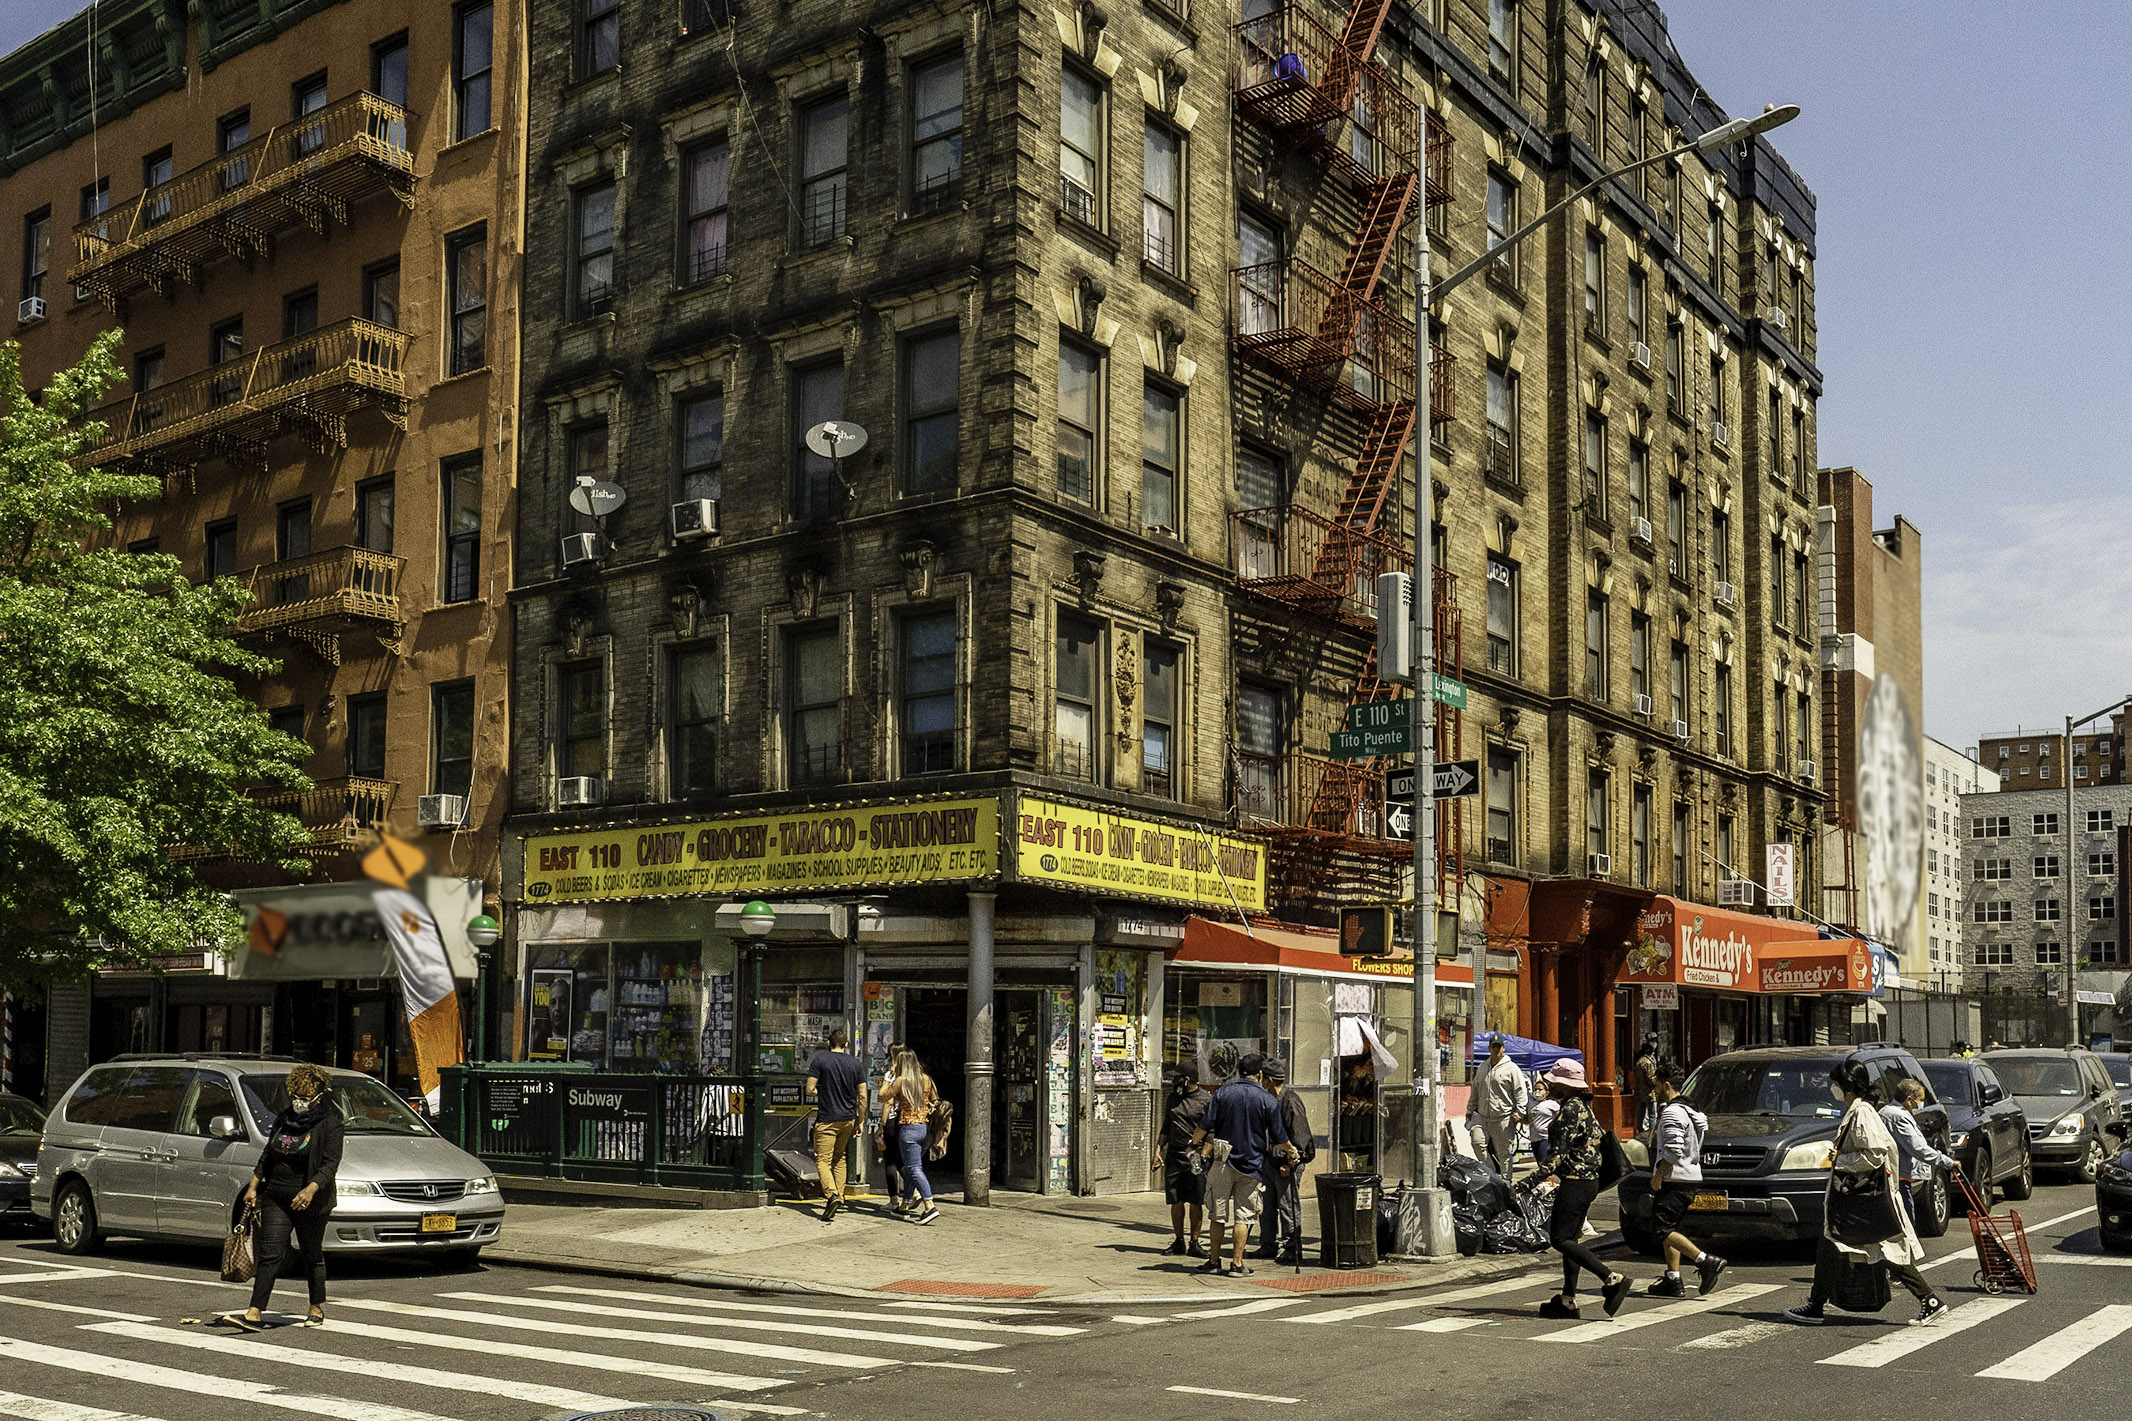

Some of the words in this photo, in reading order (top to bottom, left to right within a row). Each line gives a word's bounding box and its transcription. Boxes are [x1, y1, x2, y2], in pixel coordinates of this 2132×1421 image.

[1435, 677, 1461, 698] Lexington
[1355, 708, 1363, 727] E
[1369, 705, 1389, 726] 110
[1395, 703, 1405, 716] St
[1339, 734, 1360, 748] Tito
[1364, 731, 1403, 746] Puente
[1399, 779, 1415, 792] ON
[1436, 772, 1464, 788] WAY
[637, 831, 686, 866] CANDY
[697, 825, 768, 862] GROCERY
[779, 818, 856, 856] TABACCO
[870, 807, 978, 850] STATIONERY
[1023, 814, 1067, 848] EAST
[1073, 825, 1103, 855] 110
[1108, 823, 1135, 860] CANDY
[1141, 829, 1174, 867] GROCERY
[540, 846, 580, 872] EAST
[589, 843, 621, 869] 110
[556, 877, 571, 894] COLD
[572, 876, 592, 892] BEERS
[603, 874, 625, 891] SODAS
[630, 873, 640, 889] ICE
[641, 871, 662, 888] CREAM
[667, 868, 710, 887] CIGARETTES
[714, 864, 761, 884] NEWSPAPERS
[766, 861, 807, 880] MAGAZINES
[813, 859, 844, 878] SCHOOL
[846, 855, 883, 876] SUPPLIES
[889, 853, 921, 874] BEAUTY
[1772, 845, 1788, 898] NAILS
[1681, 924, 1752, 984] Kennedy's
[1392, 963, 1414, 975] SHOP
[1762, 966, 1845, 987] Kennedy's
[534, 991, 550, 1006] YOU
[1645, 988, 1675, 999] ATM
[869, 1012, 894, 1020] CANS
[568, 1089, 623, 1111] Subway
